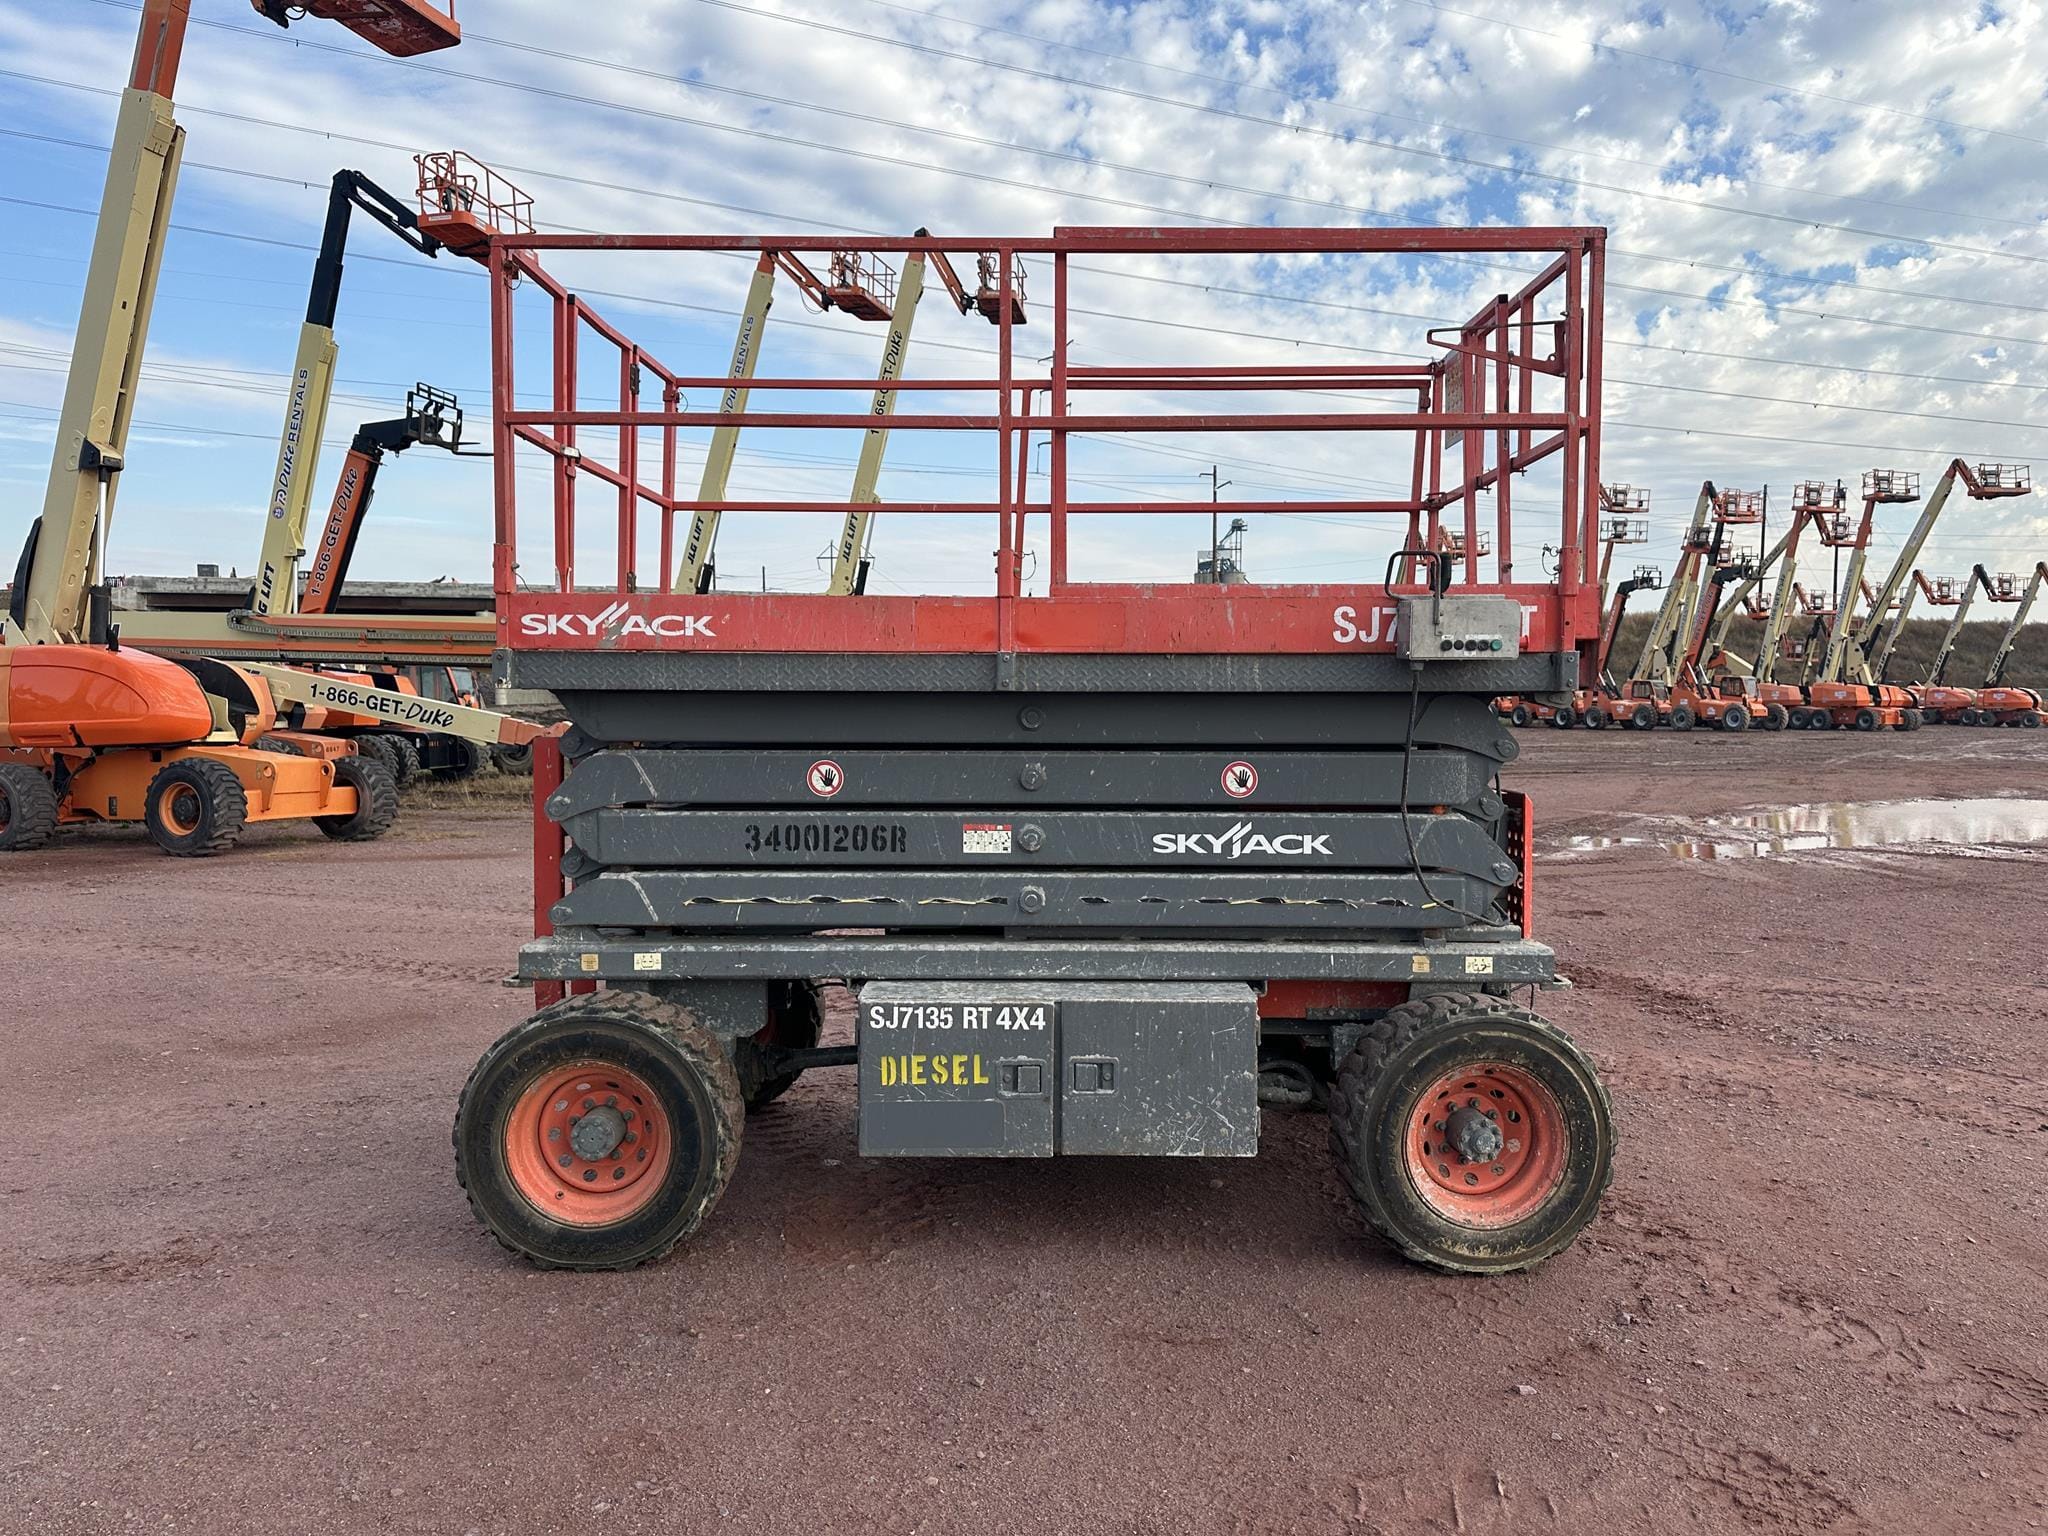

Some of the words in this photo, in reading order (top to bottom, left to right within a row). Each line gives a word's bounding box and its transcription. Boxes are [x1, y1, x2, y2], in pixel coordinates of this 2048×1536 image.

[735, 316, 754, 374] RENTALS
[279, 445, 295, 489] Duke
[287, 369, 308, 442] RENTALS
[310, 467, 358, 597] 1-866-GET-Duke
[687, 543, 698, 565] JLG
[693, 516, 704, 542] LIFT
[847, 513, 858, 540] LIFT
[842, 541, 853, 563] JLG
[261, 562, 275, 597] LIFT
[310, 683, 455, 728] 1-866-GET-Duke
[744, 824, 907, 853] 34001206R
[1152, 821, 1334, 860] SKYJACK
[869, 1005, 954, 1030] SJ7135
[963, 1006, 993, 1030] RT
[995, 1006, 1046, 1031] 4X4
[880, 1054, 990, 1087] DIESEL
